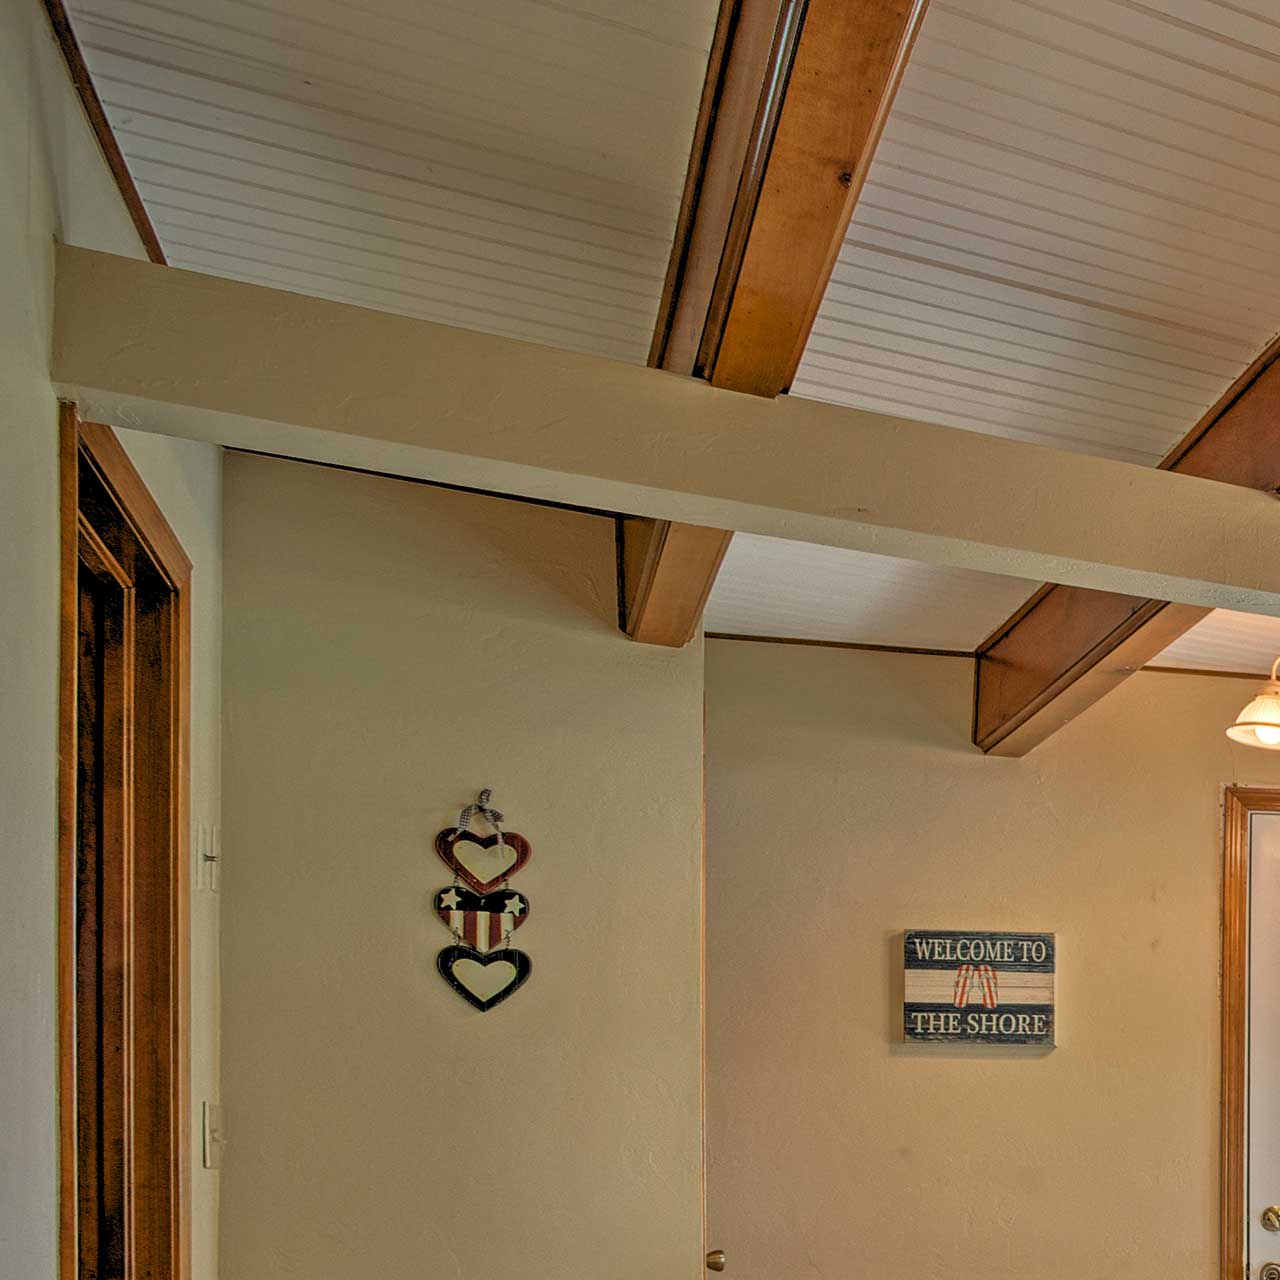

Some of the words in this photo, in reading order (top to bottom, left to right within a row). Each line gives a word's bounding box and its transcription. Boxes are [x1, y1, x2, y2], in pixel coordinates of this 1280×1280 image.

[913, 938, 1015, 962] WELCOME
[1018, 941, 1046, 962] TO
[911, 1012, 961, 1034] THE
[967, 1013, 1046, 1035] SHORE
